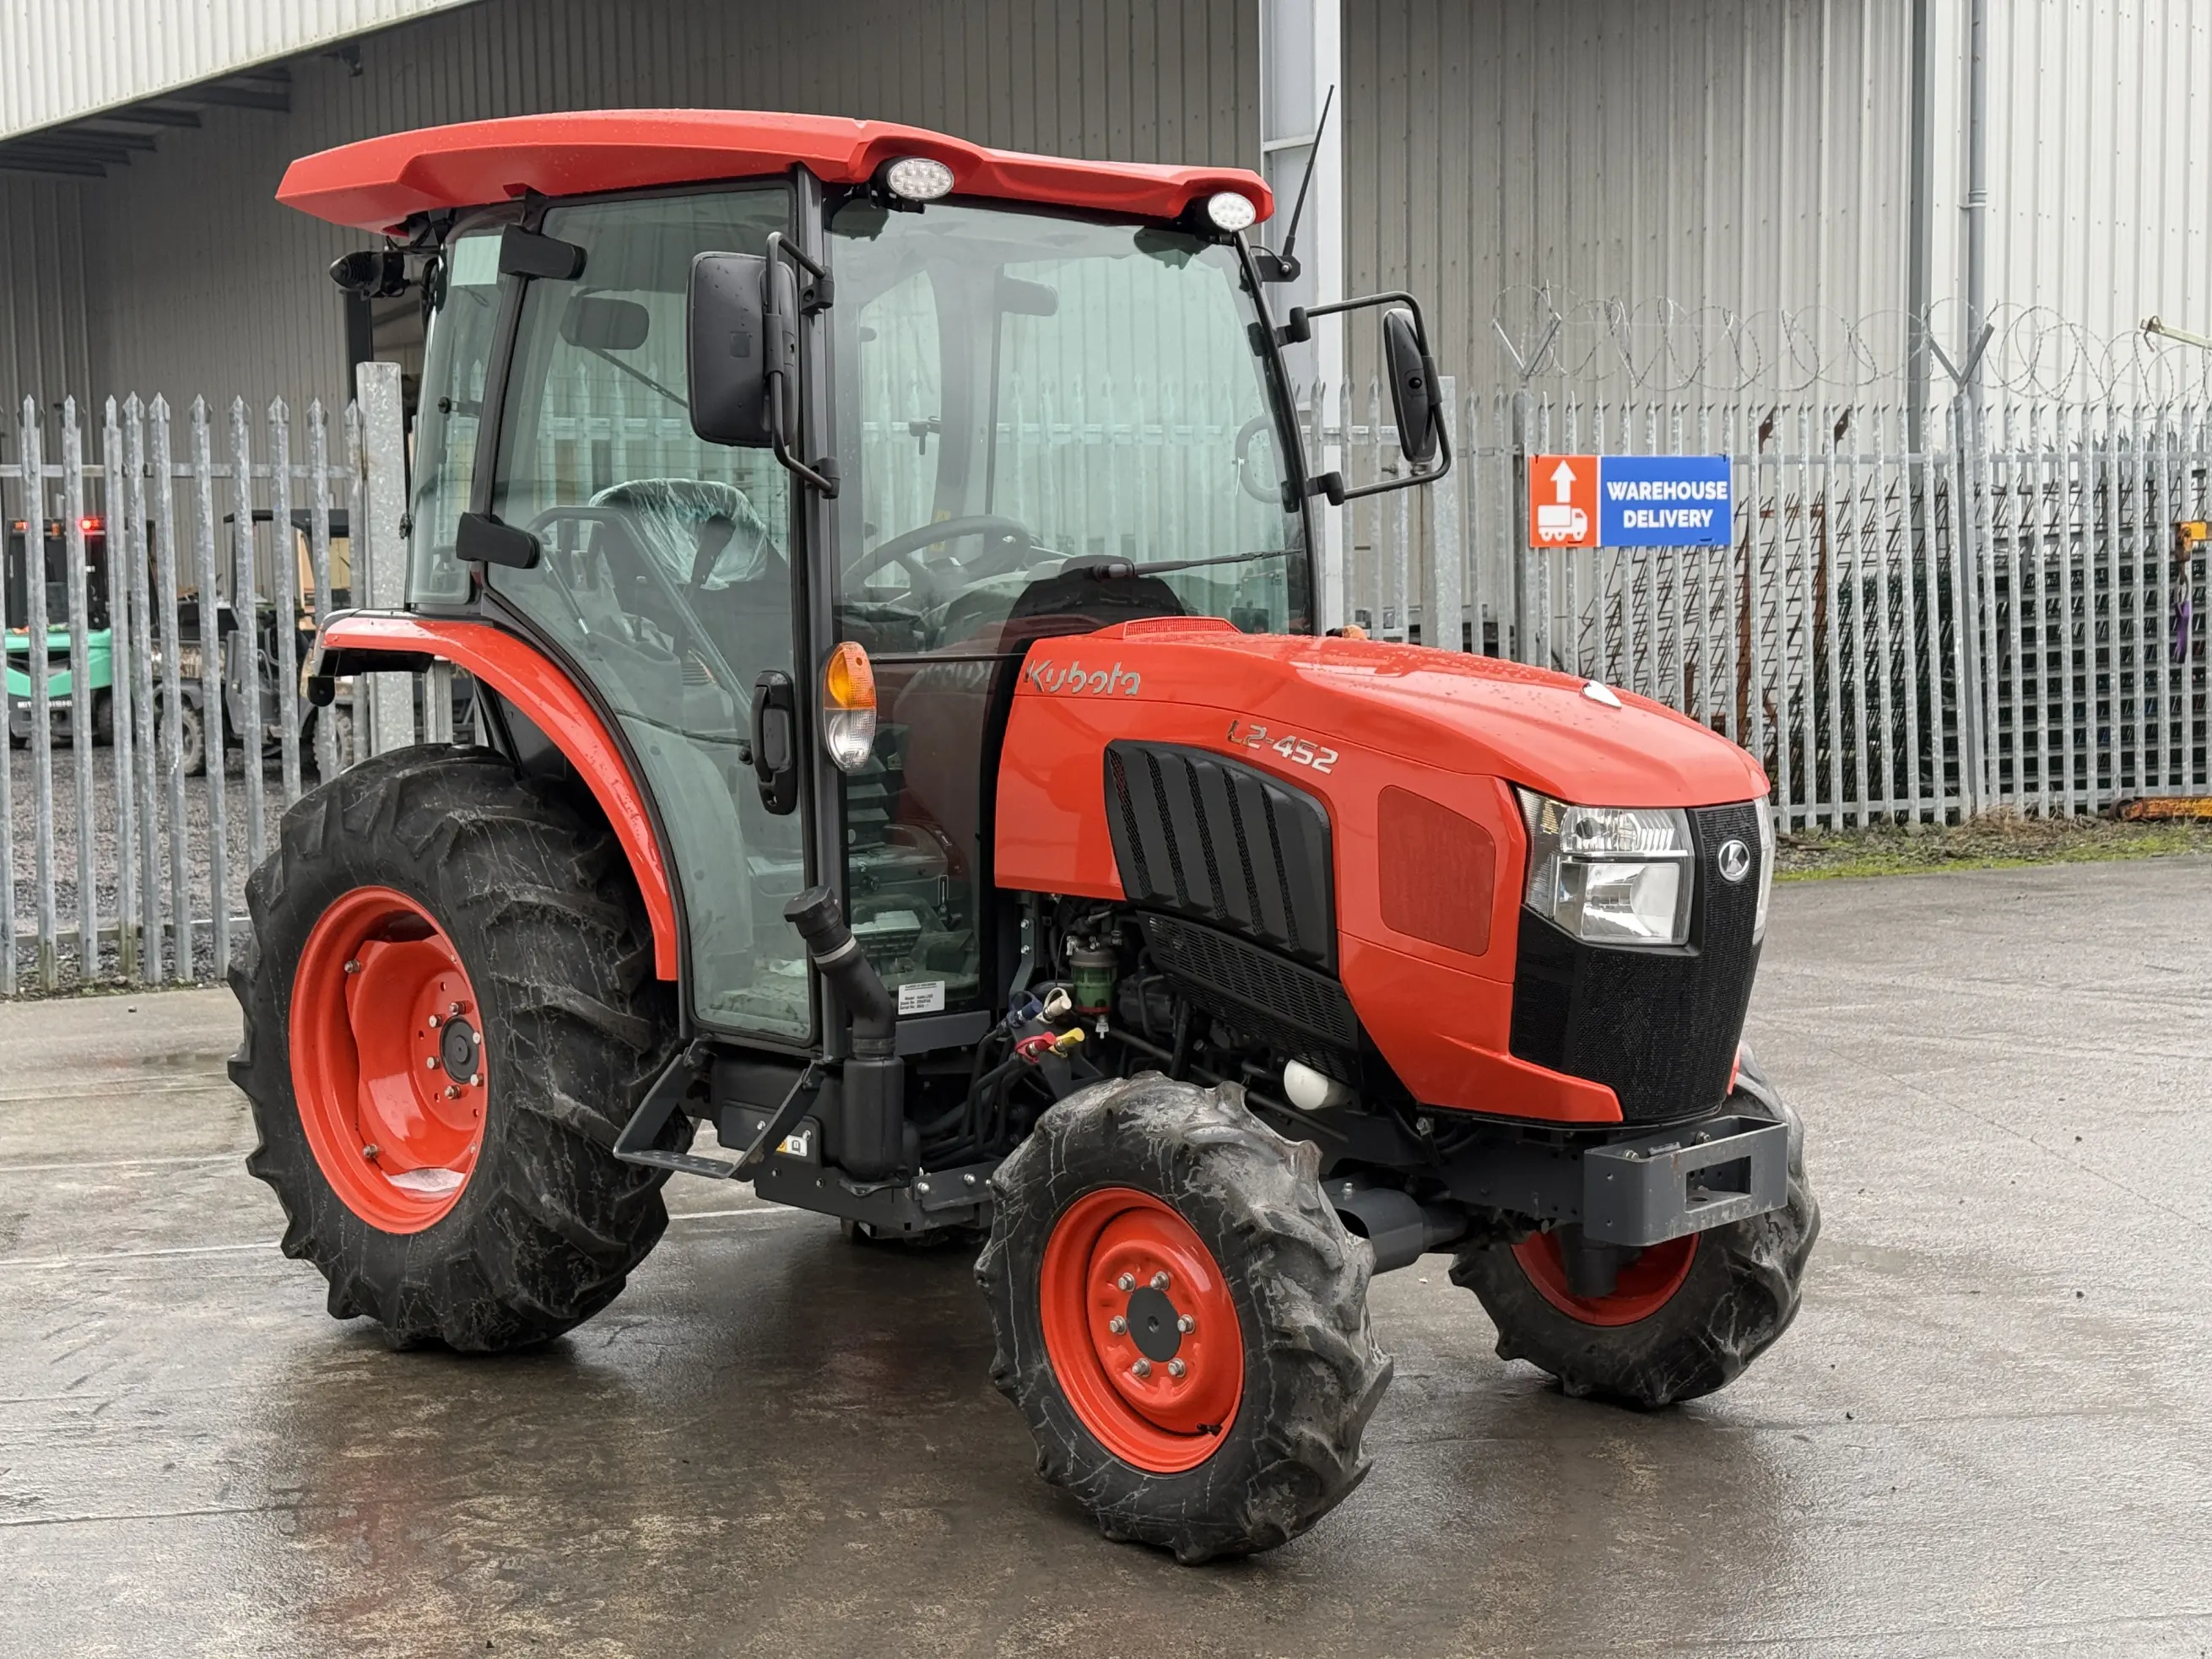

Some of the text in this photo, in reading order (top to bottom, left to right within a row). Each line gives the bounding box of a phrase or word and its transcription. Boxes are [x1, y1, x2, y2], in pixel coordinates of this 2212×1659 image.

[1606, 481, 1728, 500] WAREHOUSE
[1623, 509, 1714, 528] DELIVERY
[1024, 659, 1141, 695] Kubota
[1227, 719, 1339, 775] L2-452
